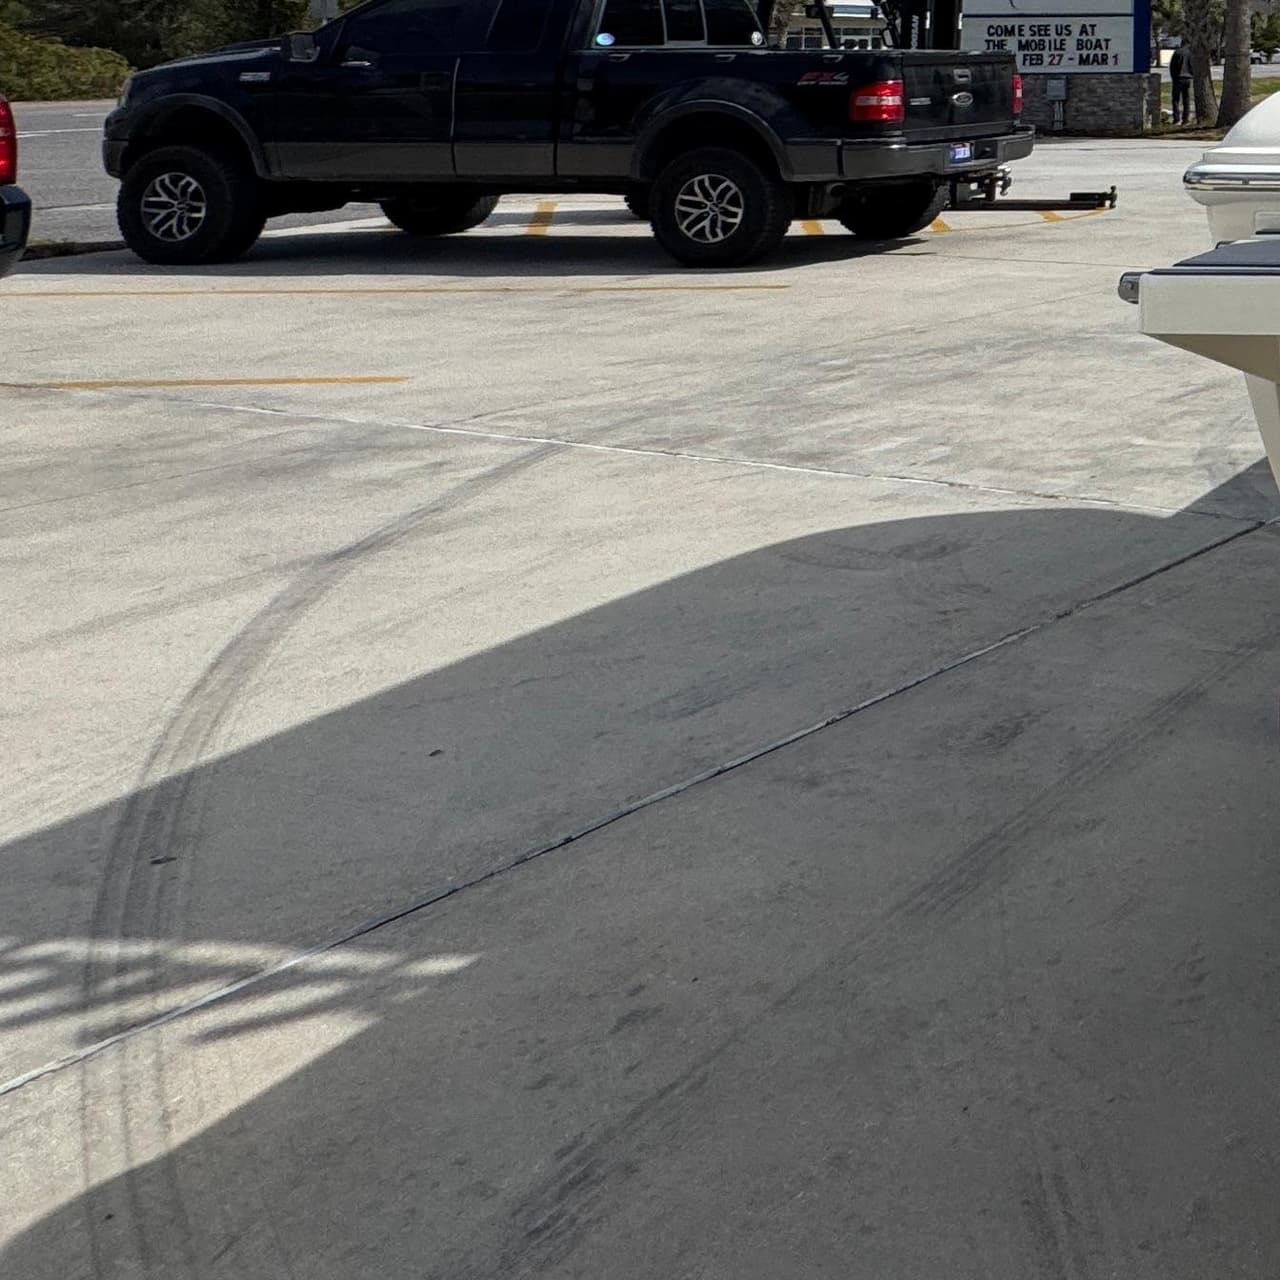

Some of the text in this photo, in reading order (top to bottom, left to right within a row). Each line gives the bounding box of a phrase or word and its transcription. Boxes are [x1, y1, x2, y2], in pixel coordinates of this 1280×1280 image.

[987, 23, 1097, 37] COME SEE US AT
[984, 38, 1112, 52] THE MOBILE BOAT
[1022, 53, 1044, 66] FEB
[1049, 53, 1065, 66] 27
[1078, 53, 1109, 66] MAR
[1112, 54, 1120, 66] 1
[800, 71, 851, 82] FX4
